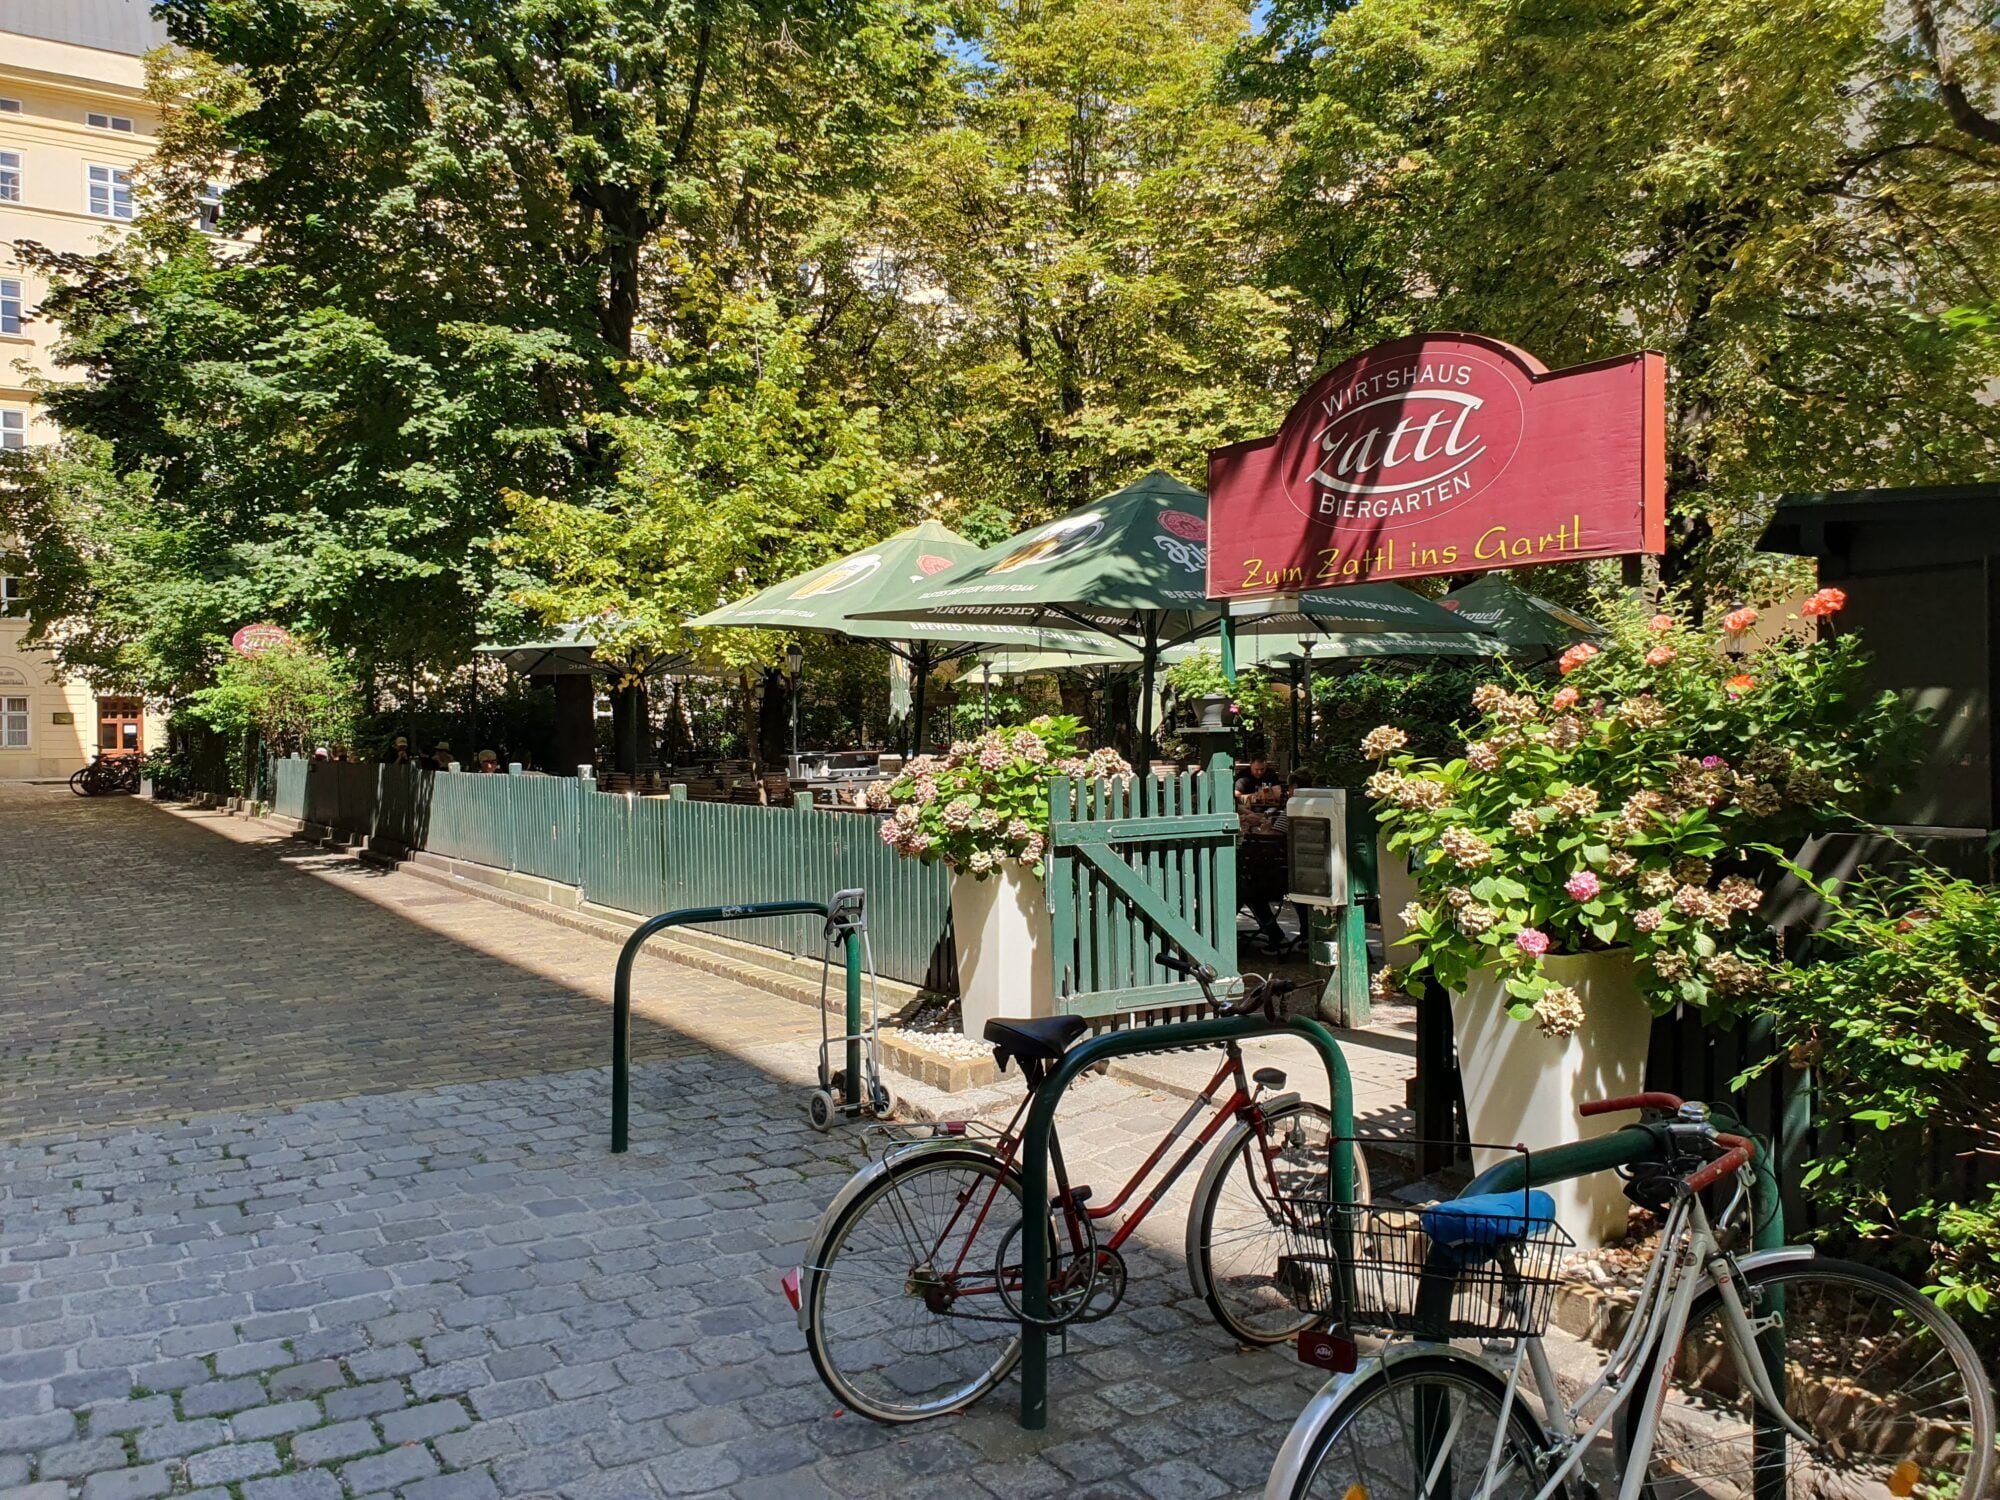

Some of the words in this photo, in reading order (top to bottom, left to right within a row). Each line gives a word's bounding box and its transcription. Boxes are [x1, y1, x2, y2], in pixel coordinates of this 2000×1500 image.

[1321, 365, 1473, 417] WIRTSHAUS
[1318, 471, 1472, 519] BIERGARTEN
[1241, 558, 1302, 588] Zum
[1316, 539, 1394, 579] Zattl
[1410, 541, 1458, 567] ins
[1474, 515, 1580, 560] Gartl
[909, 622, 962, 632] BREWED
[964, 623, 979, 632] IN
[1349, 599, 1420, 615] REPUBLIC
